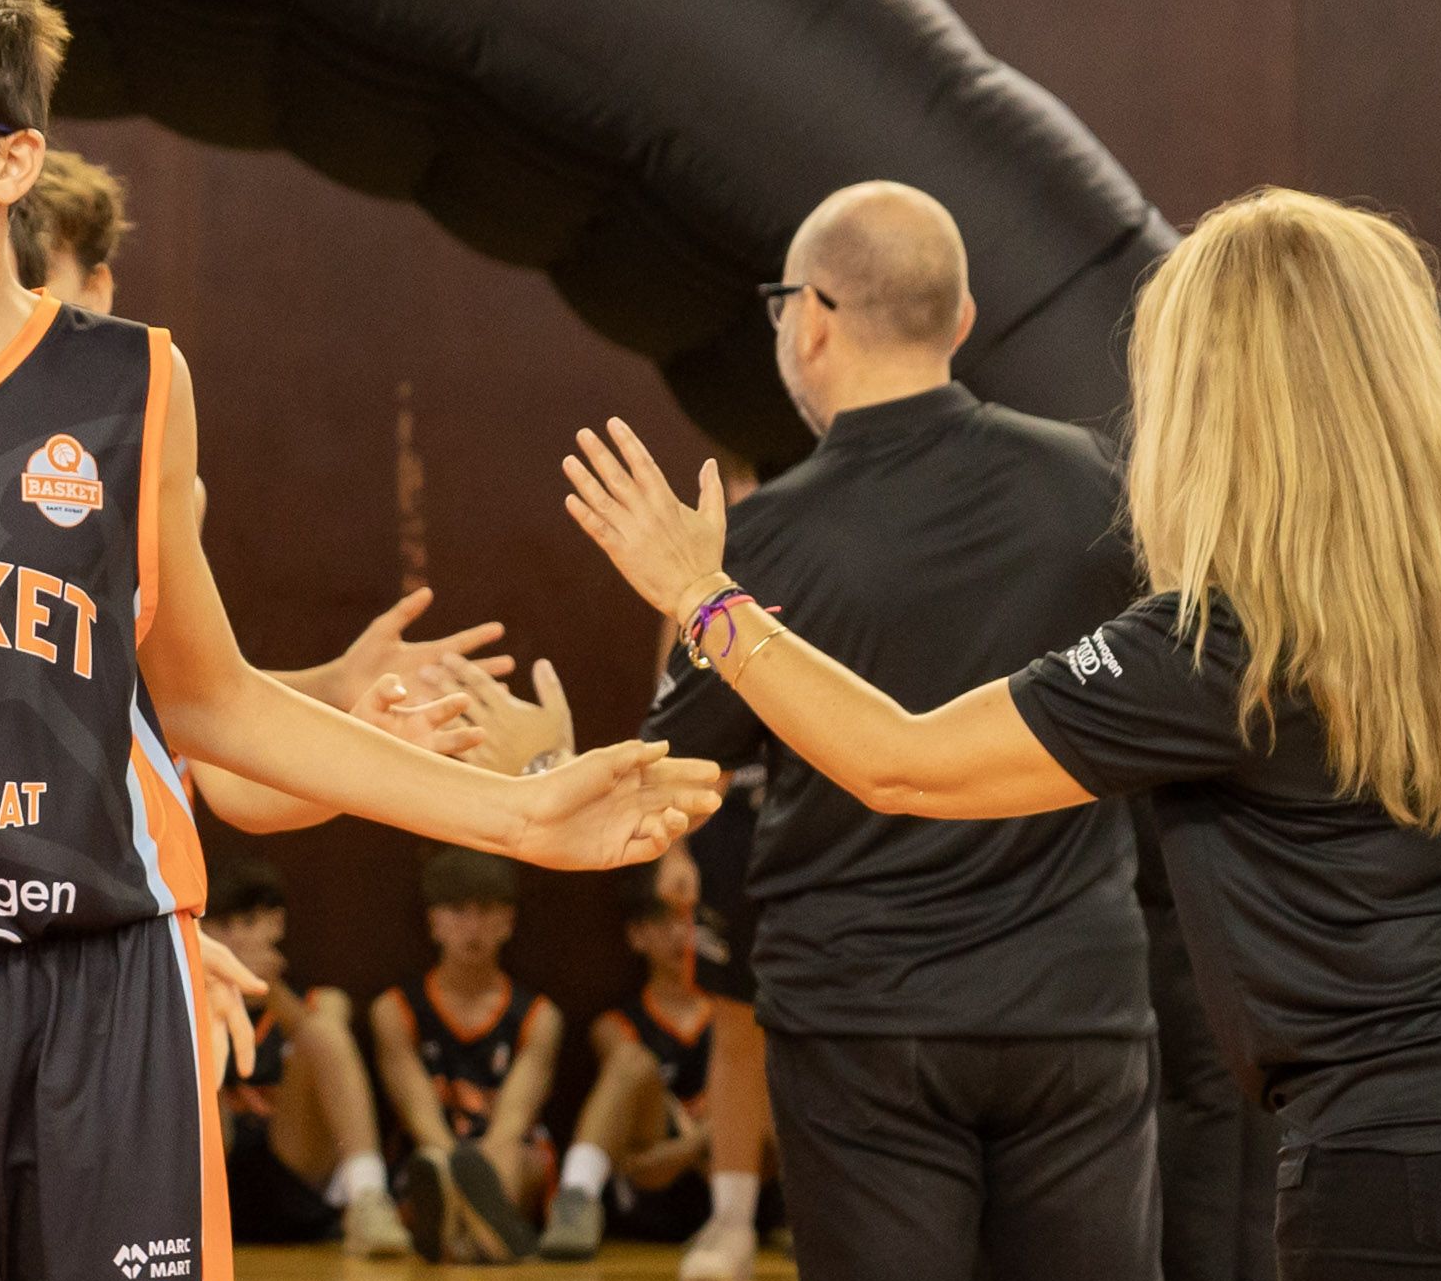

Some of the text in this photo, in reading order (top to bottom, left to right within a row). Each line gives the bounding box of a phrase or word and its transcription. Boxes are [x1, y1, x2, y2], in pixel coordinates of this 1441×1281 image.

[27, 479, 98, 502] BASKET
[148, 1237, 192, 1257] MARC
[150, 1259, 192, 1279] MART
